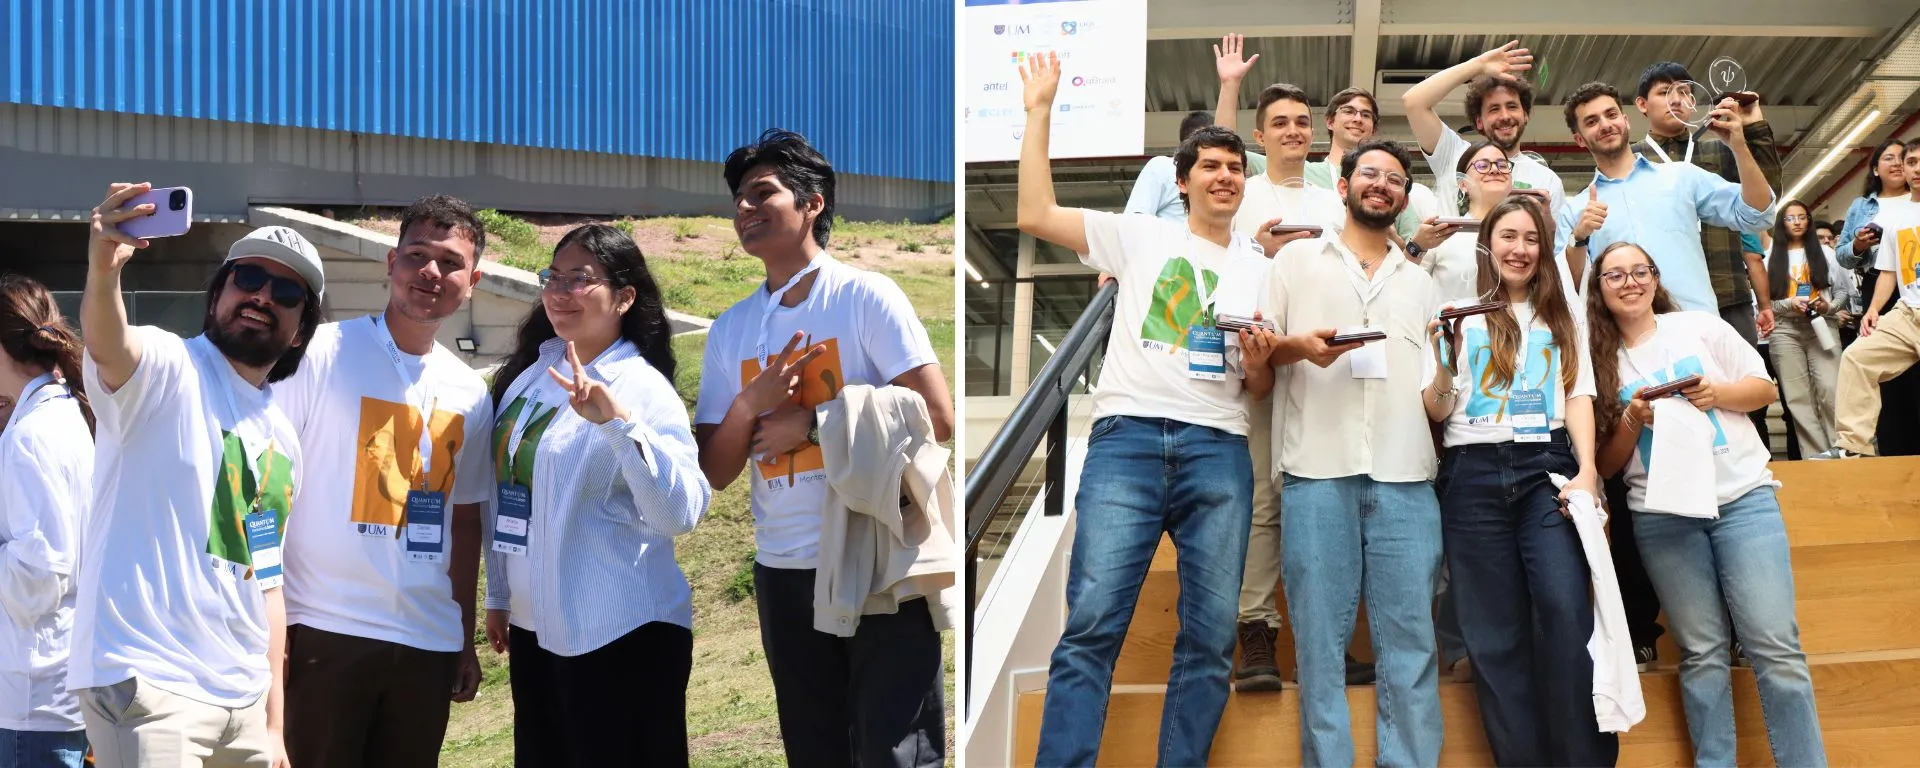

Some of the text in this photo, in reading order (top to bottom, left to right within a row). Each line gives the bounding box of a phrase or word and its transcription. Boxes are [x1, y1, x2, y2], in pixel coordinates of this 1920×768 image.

[1007, 24, 1031, 35] UM
[983, 81, 1008, 92] antel
[411, 496, 441, 505] QUANTUM
[249, 517, 275, 529] QUANTUM
[368, 524, 387, 536] UM
